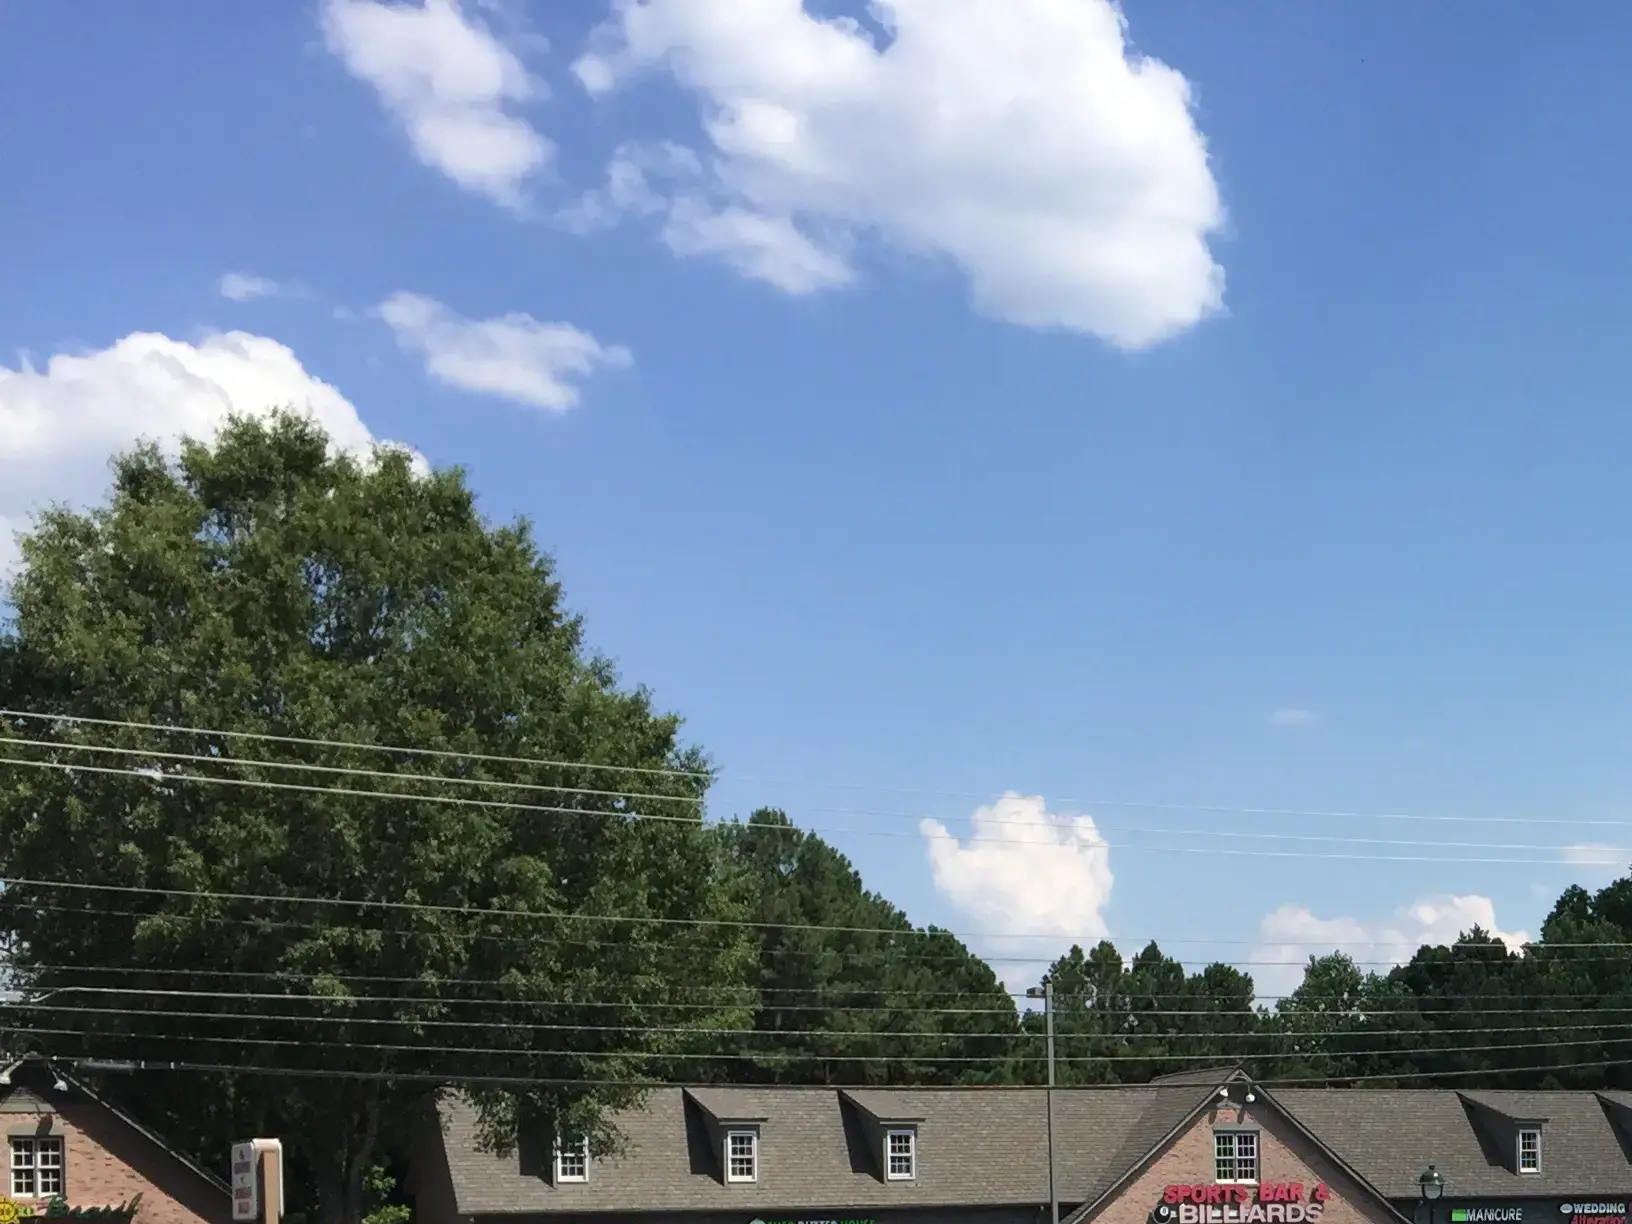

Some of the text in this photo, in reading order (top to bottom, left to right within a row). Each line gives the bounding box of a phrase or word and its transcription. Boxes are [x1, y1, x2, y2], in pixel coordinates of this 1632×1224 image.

[1164, 1183, 1330, 1203] SPORTS BAR &
[1179, 1204, 1323, 1224] BILLIARDS
[1466, 1207, 1522, 1221] MANICURE
[1573, 1203, 1626, 1214] WEDDING
